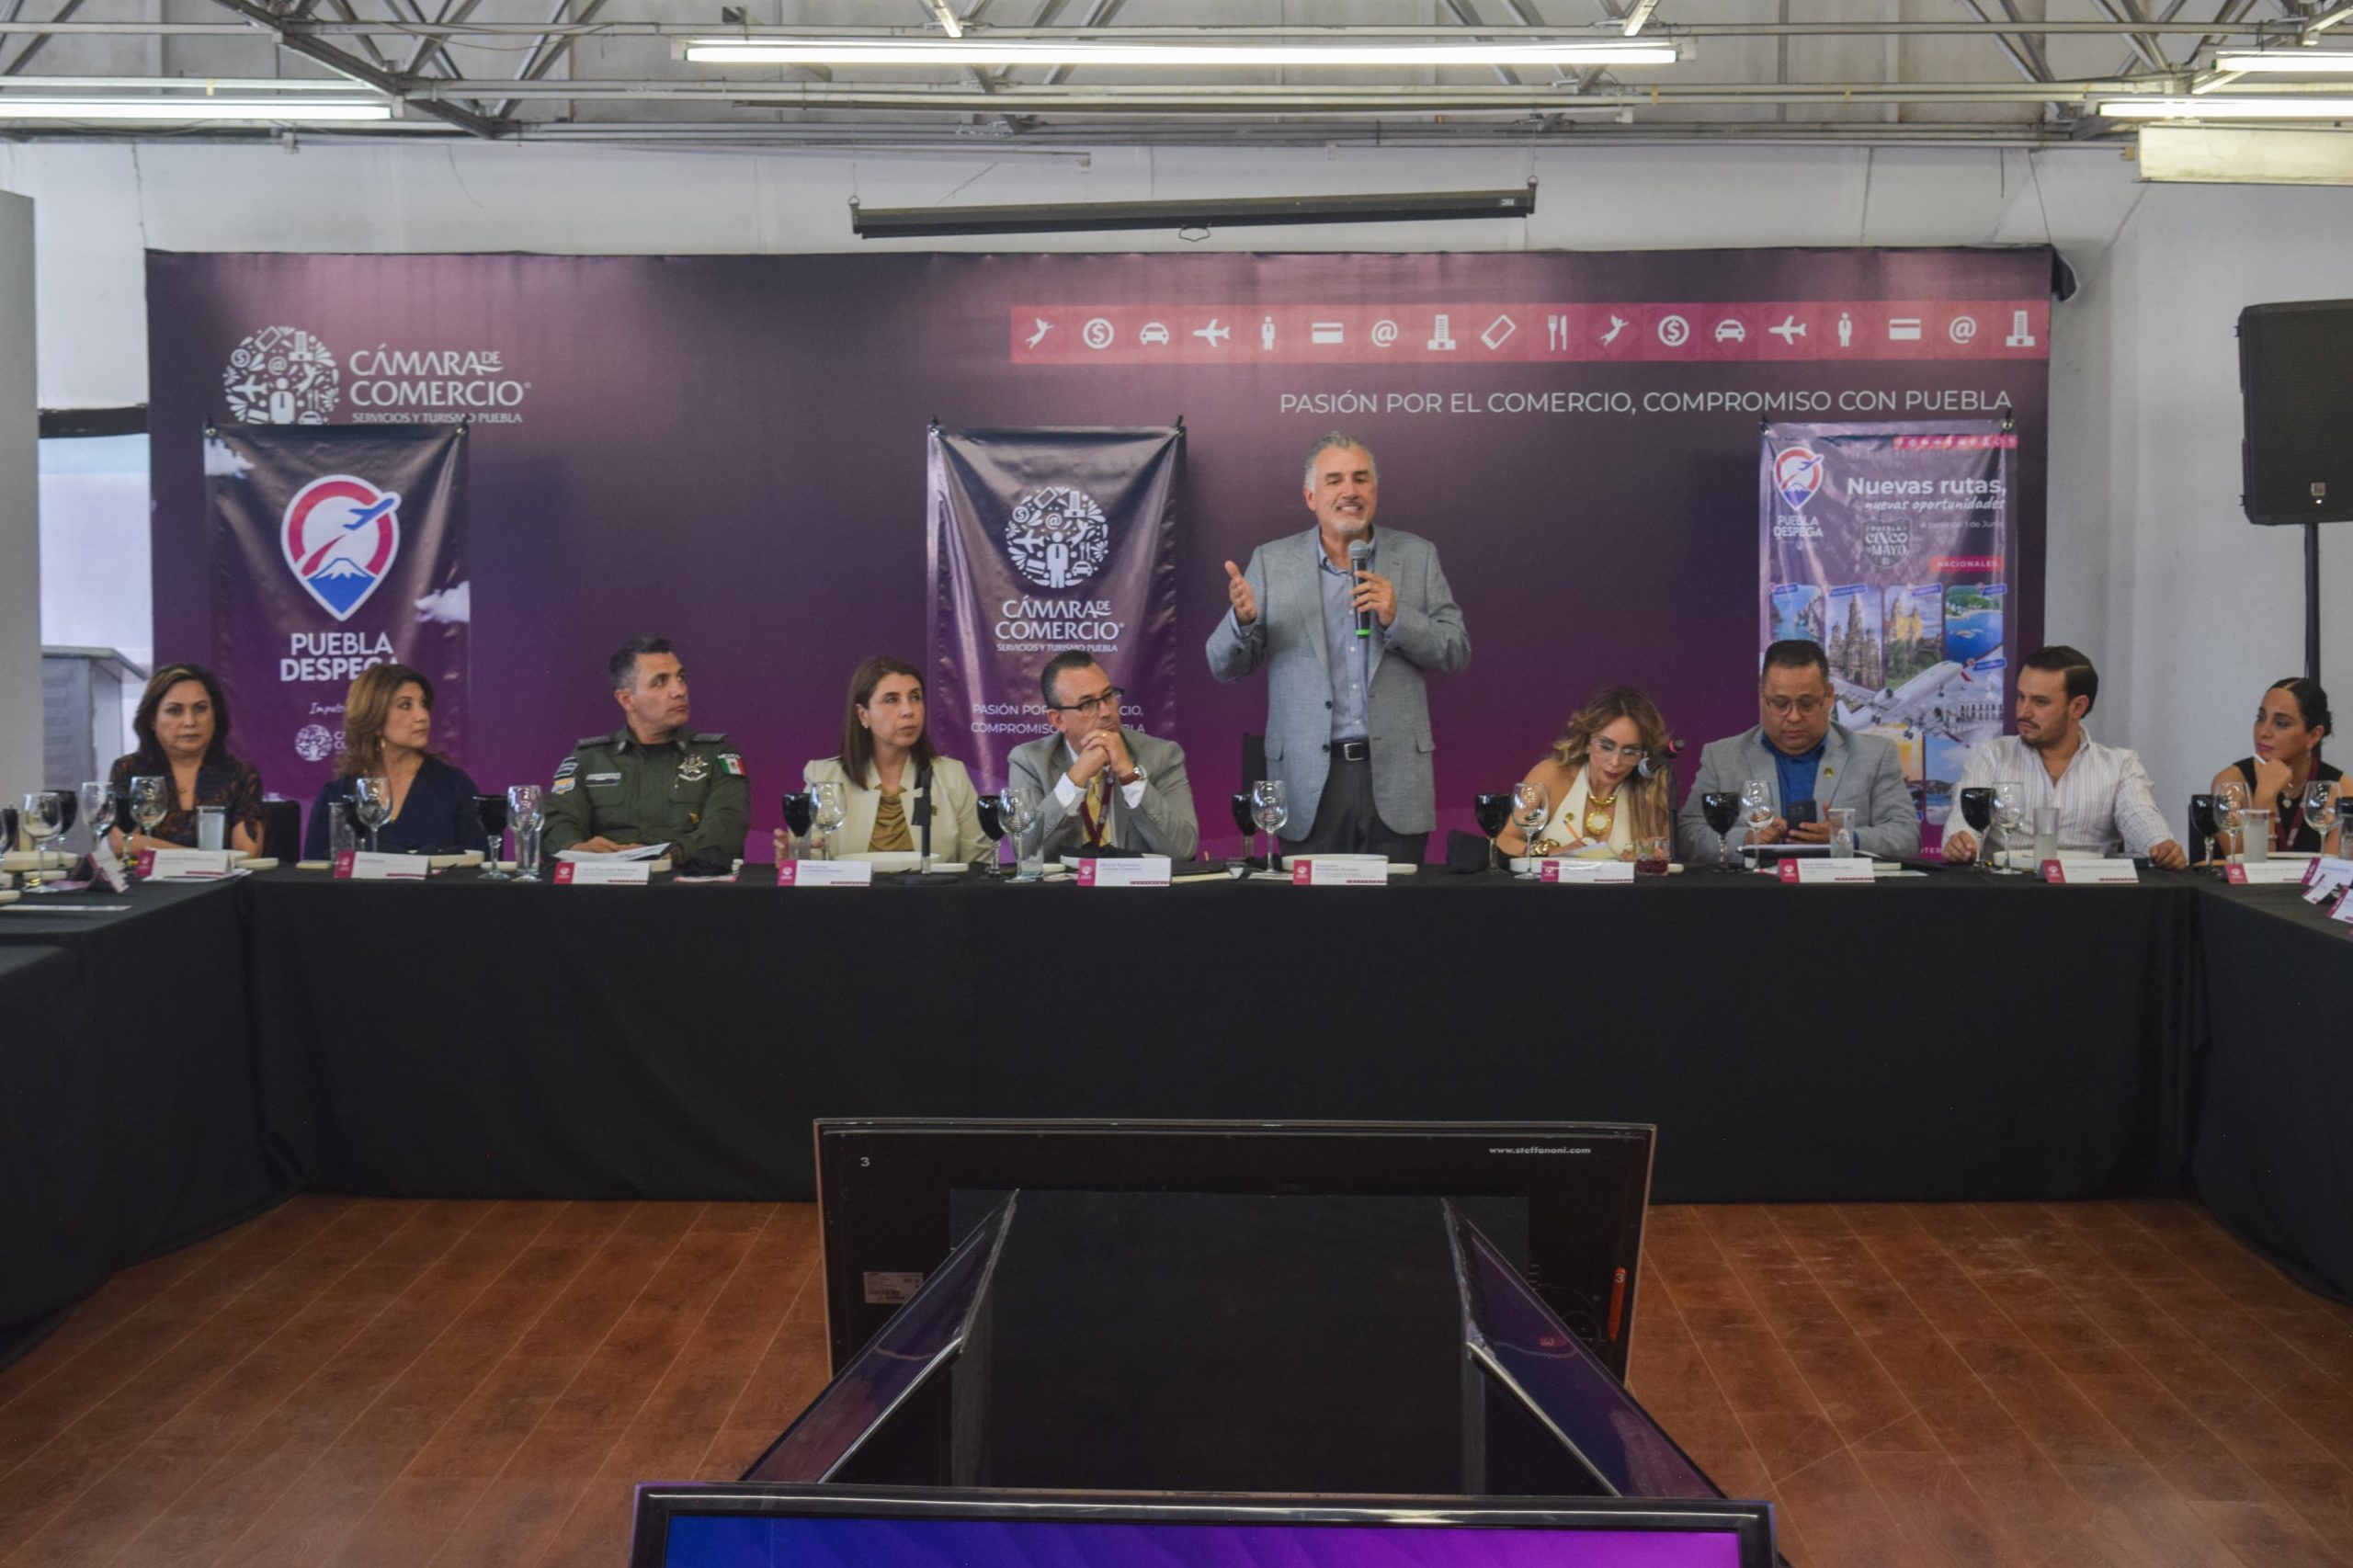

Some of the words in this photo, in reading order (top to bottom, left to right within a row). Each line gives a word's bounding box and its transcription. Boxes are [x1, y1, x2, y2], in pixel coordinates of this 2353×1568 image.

[349, 343, 485, 376] CÁMARA
[482, 351, 500, 364] DE
[349, 381, 524, 406] COMERCIO
[1279, 390, 1377, 414] PASIÓN
[1386, 392, 1442, 413] POR
[1450, 393, 1482, 413] EL
[1487, 392, 1637, 415] COMERCIO,
[1643, 391, 1832, 412] COMPROMISO
[1838, 391, 1897, 411] CON
[1904, 390, 2012, 410] PUEBLA
[352, 413, 411, 423] SERVICIOS
[412, 414, 420, 423] Y
[479, 413, 522, 423] PUEBLA
[1847, 477, 1934, 496] Nuevas
[1940, 477, 2006, 497] rutas,
[1865, 499, 1909, 511] nuevas
[1912, 495, 2006, 513] oportunidades
[1777, 515, 1820, 527] PUEBLA
[1773, 526, 1824, 538] DESPEGA
[1937, 560, 1998, 568] NACIONALES
[1002, 595, 1097, 619] CÁMARA
[1096, 600, 1111, 611] DE
[995, 620, 1120, 641] COMERCIO
[290, 631, 394, 656] PUEBLA
[995, 643, 1038, 652] SERVICIOS
[1047, 643, 1086, 652] TURISMO
[1086, 644, 1118, 653] PUEBLA
[279, 656, 399, 682] DESPE
[972, 703, 1018, 715] PASIÓN
[1489, 1146, 1592, 1154] www.steffanoni.com
[860, 1156, 870, 1167] 3
